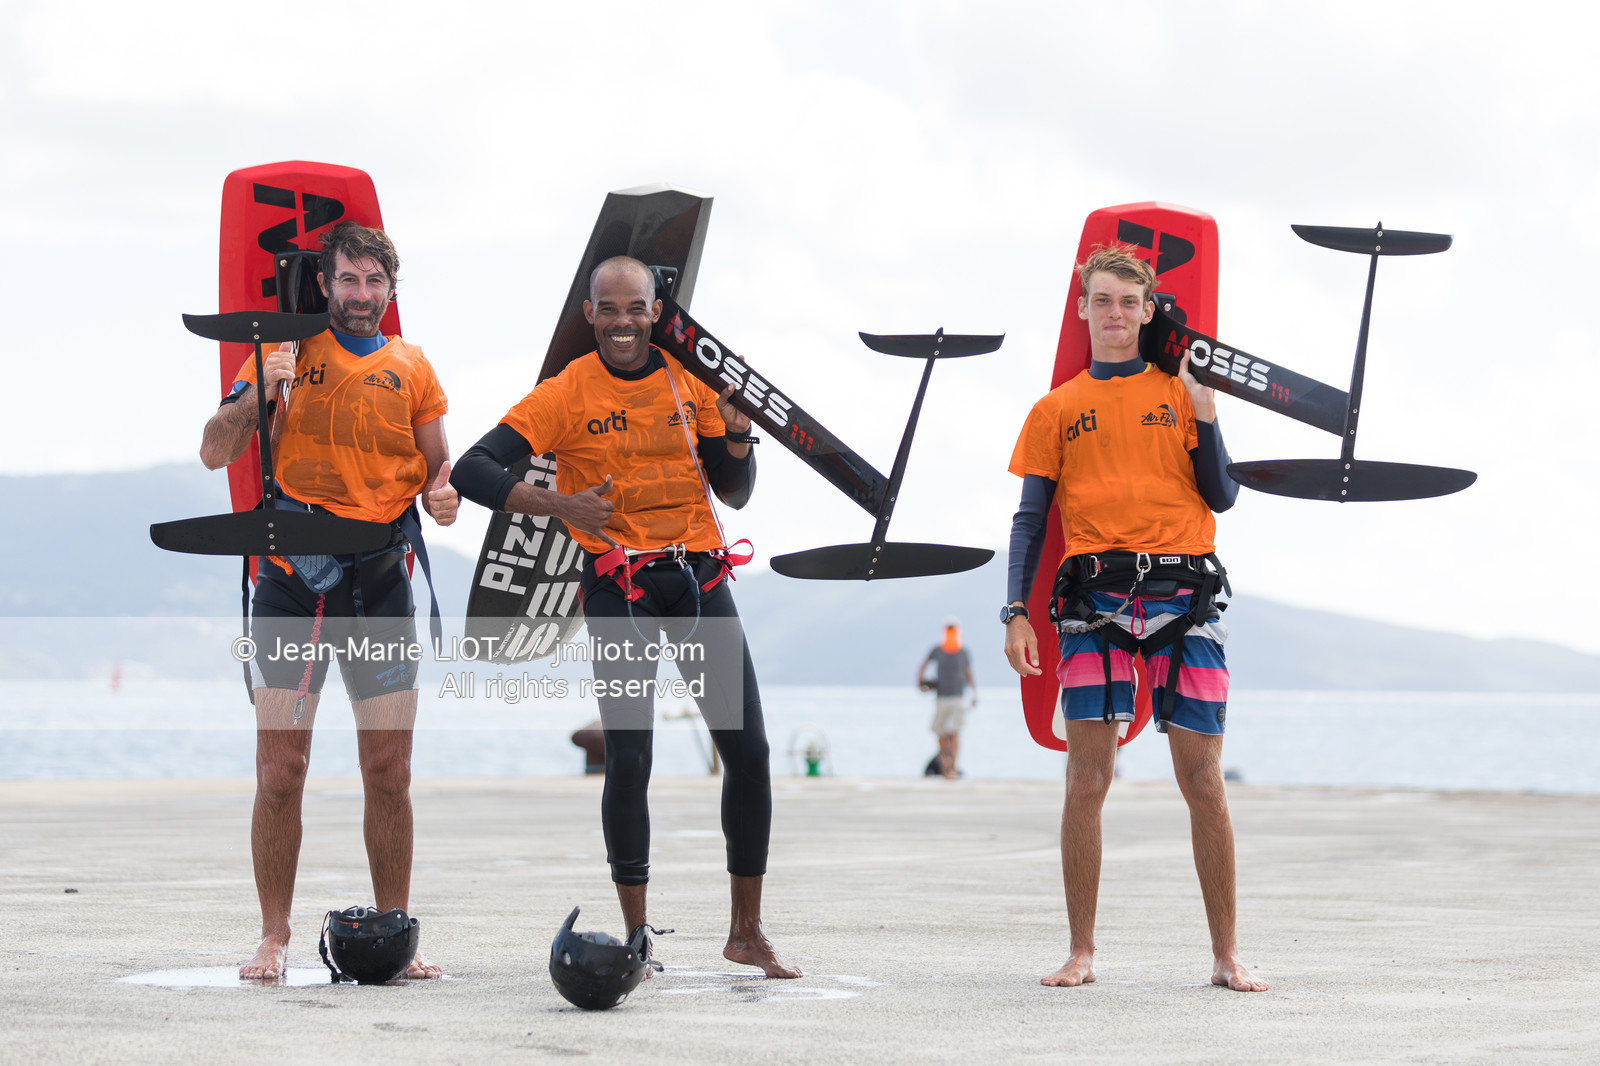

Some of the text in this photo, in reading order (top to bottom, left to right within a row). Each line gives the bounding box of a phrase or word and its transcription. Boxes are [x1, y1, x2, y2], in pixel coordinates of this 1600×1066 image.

[665, 312, 793, 427] MOSES
[1164, 330, 1271, 392] MOSES
[587, 409, 628, 435] arti
[1067, 409, 1097, 442] arti
